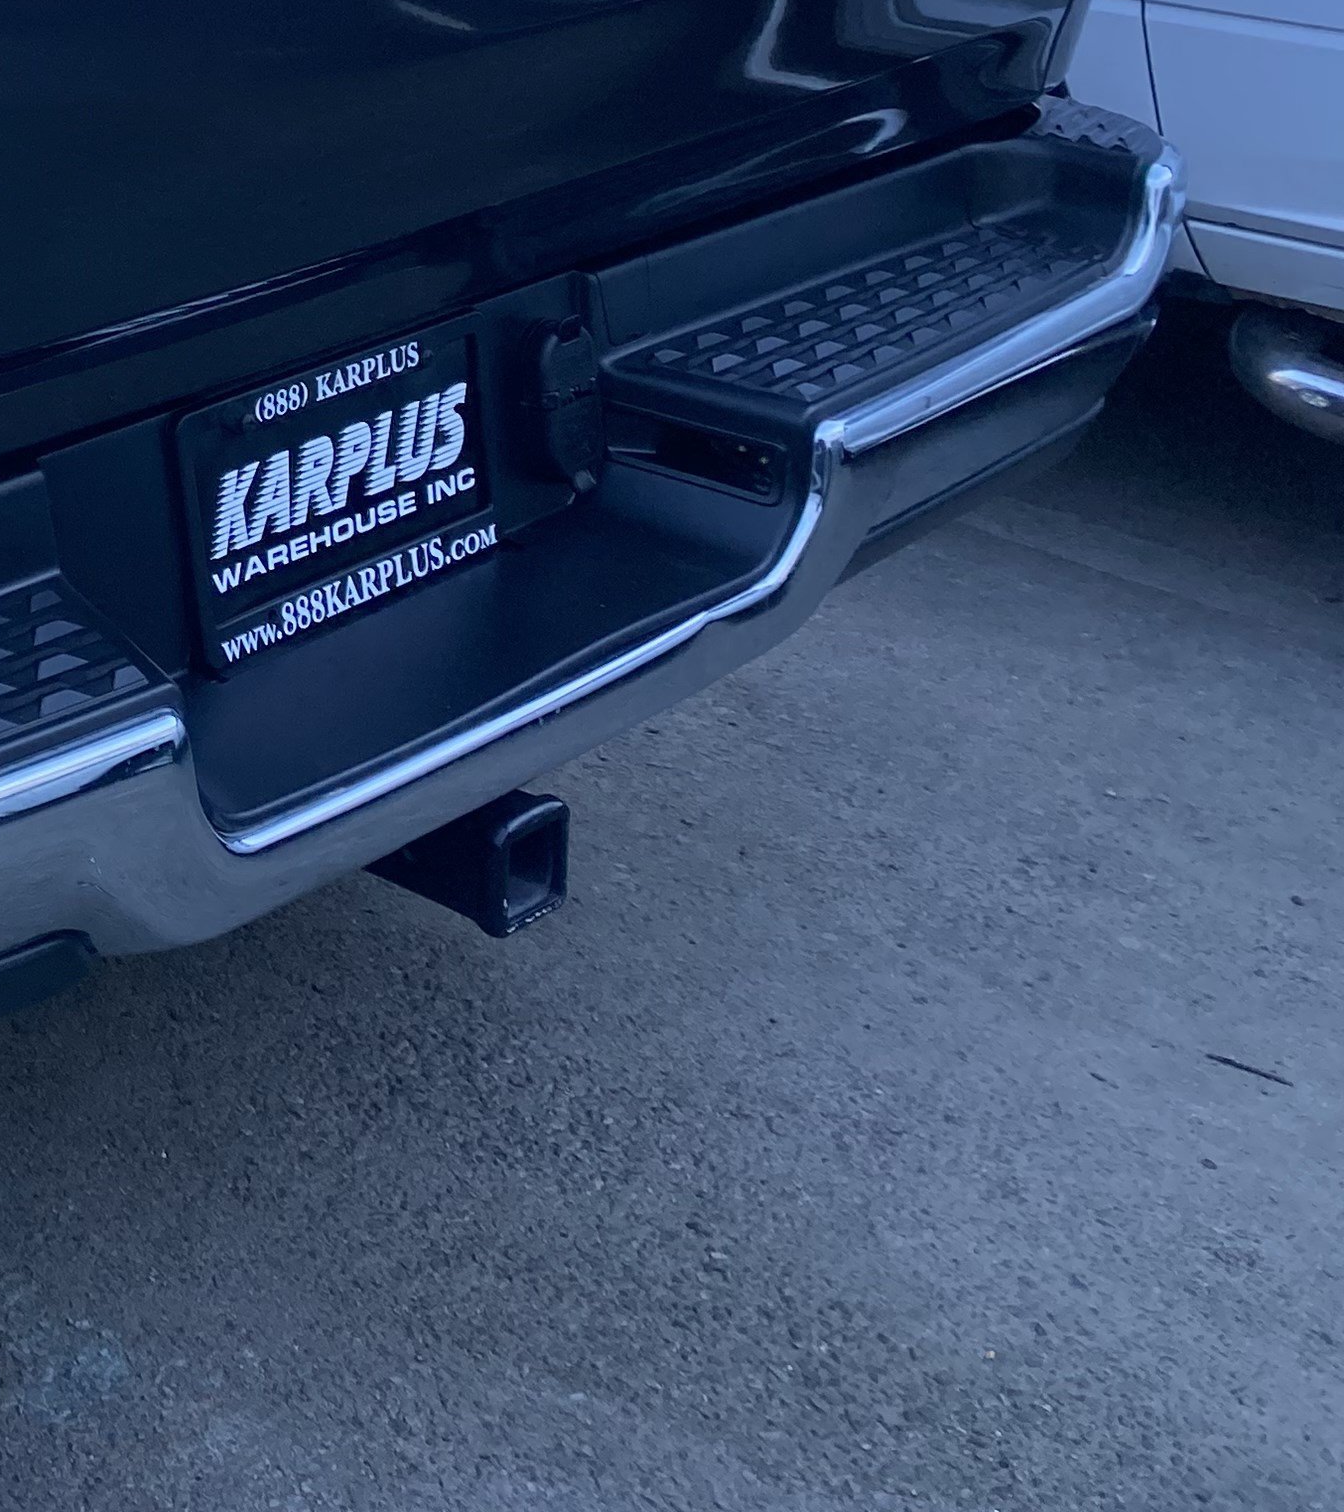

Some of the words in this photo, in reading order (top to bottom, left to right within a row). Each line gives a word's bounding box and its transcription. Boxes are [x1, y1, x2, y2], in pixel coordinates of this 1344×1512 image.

[254, 382, 309, 423] (888)
[315, 341, 420, 402] KARPLUS
[210, 382, 467, 560] KARPLUS
[212, 491, 417, 595] WAREHOUSE
[426, 467, 477, 505] INC
